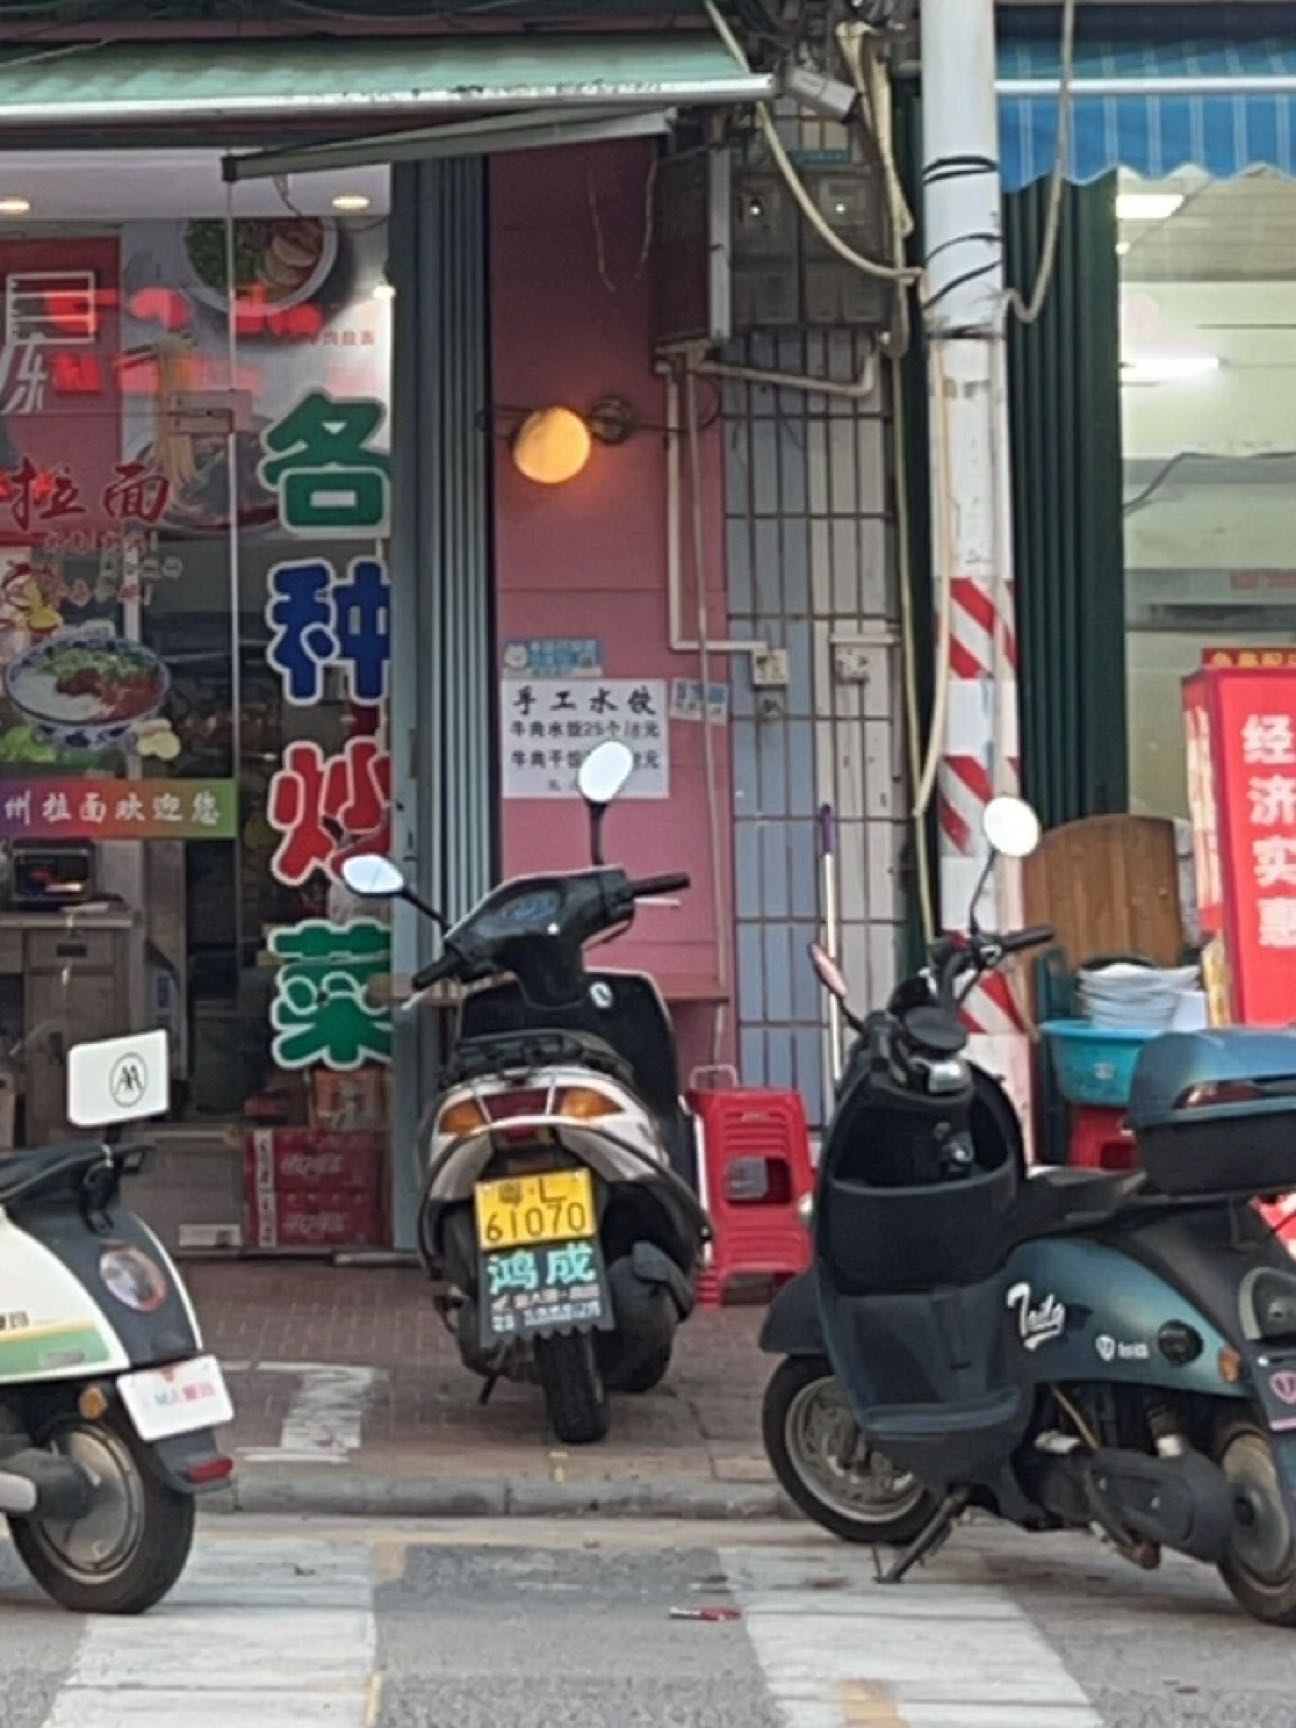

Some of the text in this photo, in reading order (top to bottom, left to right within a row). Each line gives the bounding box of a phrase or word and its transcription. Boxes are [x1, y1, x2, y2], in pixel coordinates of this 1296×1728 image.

[10, 455, 171, 532] 拉面
[513, 684, 657, 715] 手工水饺
[485, 1201, 587, 1243] 61070
